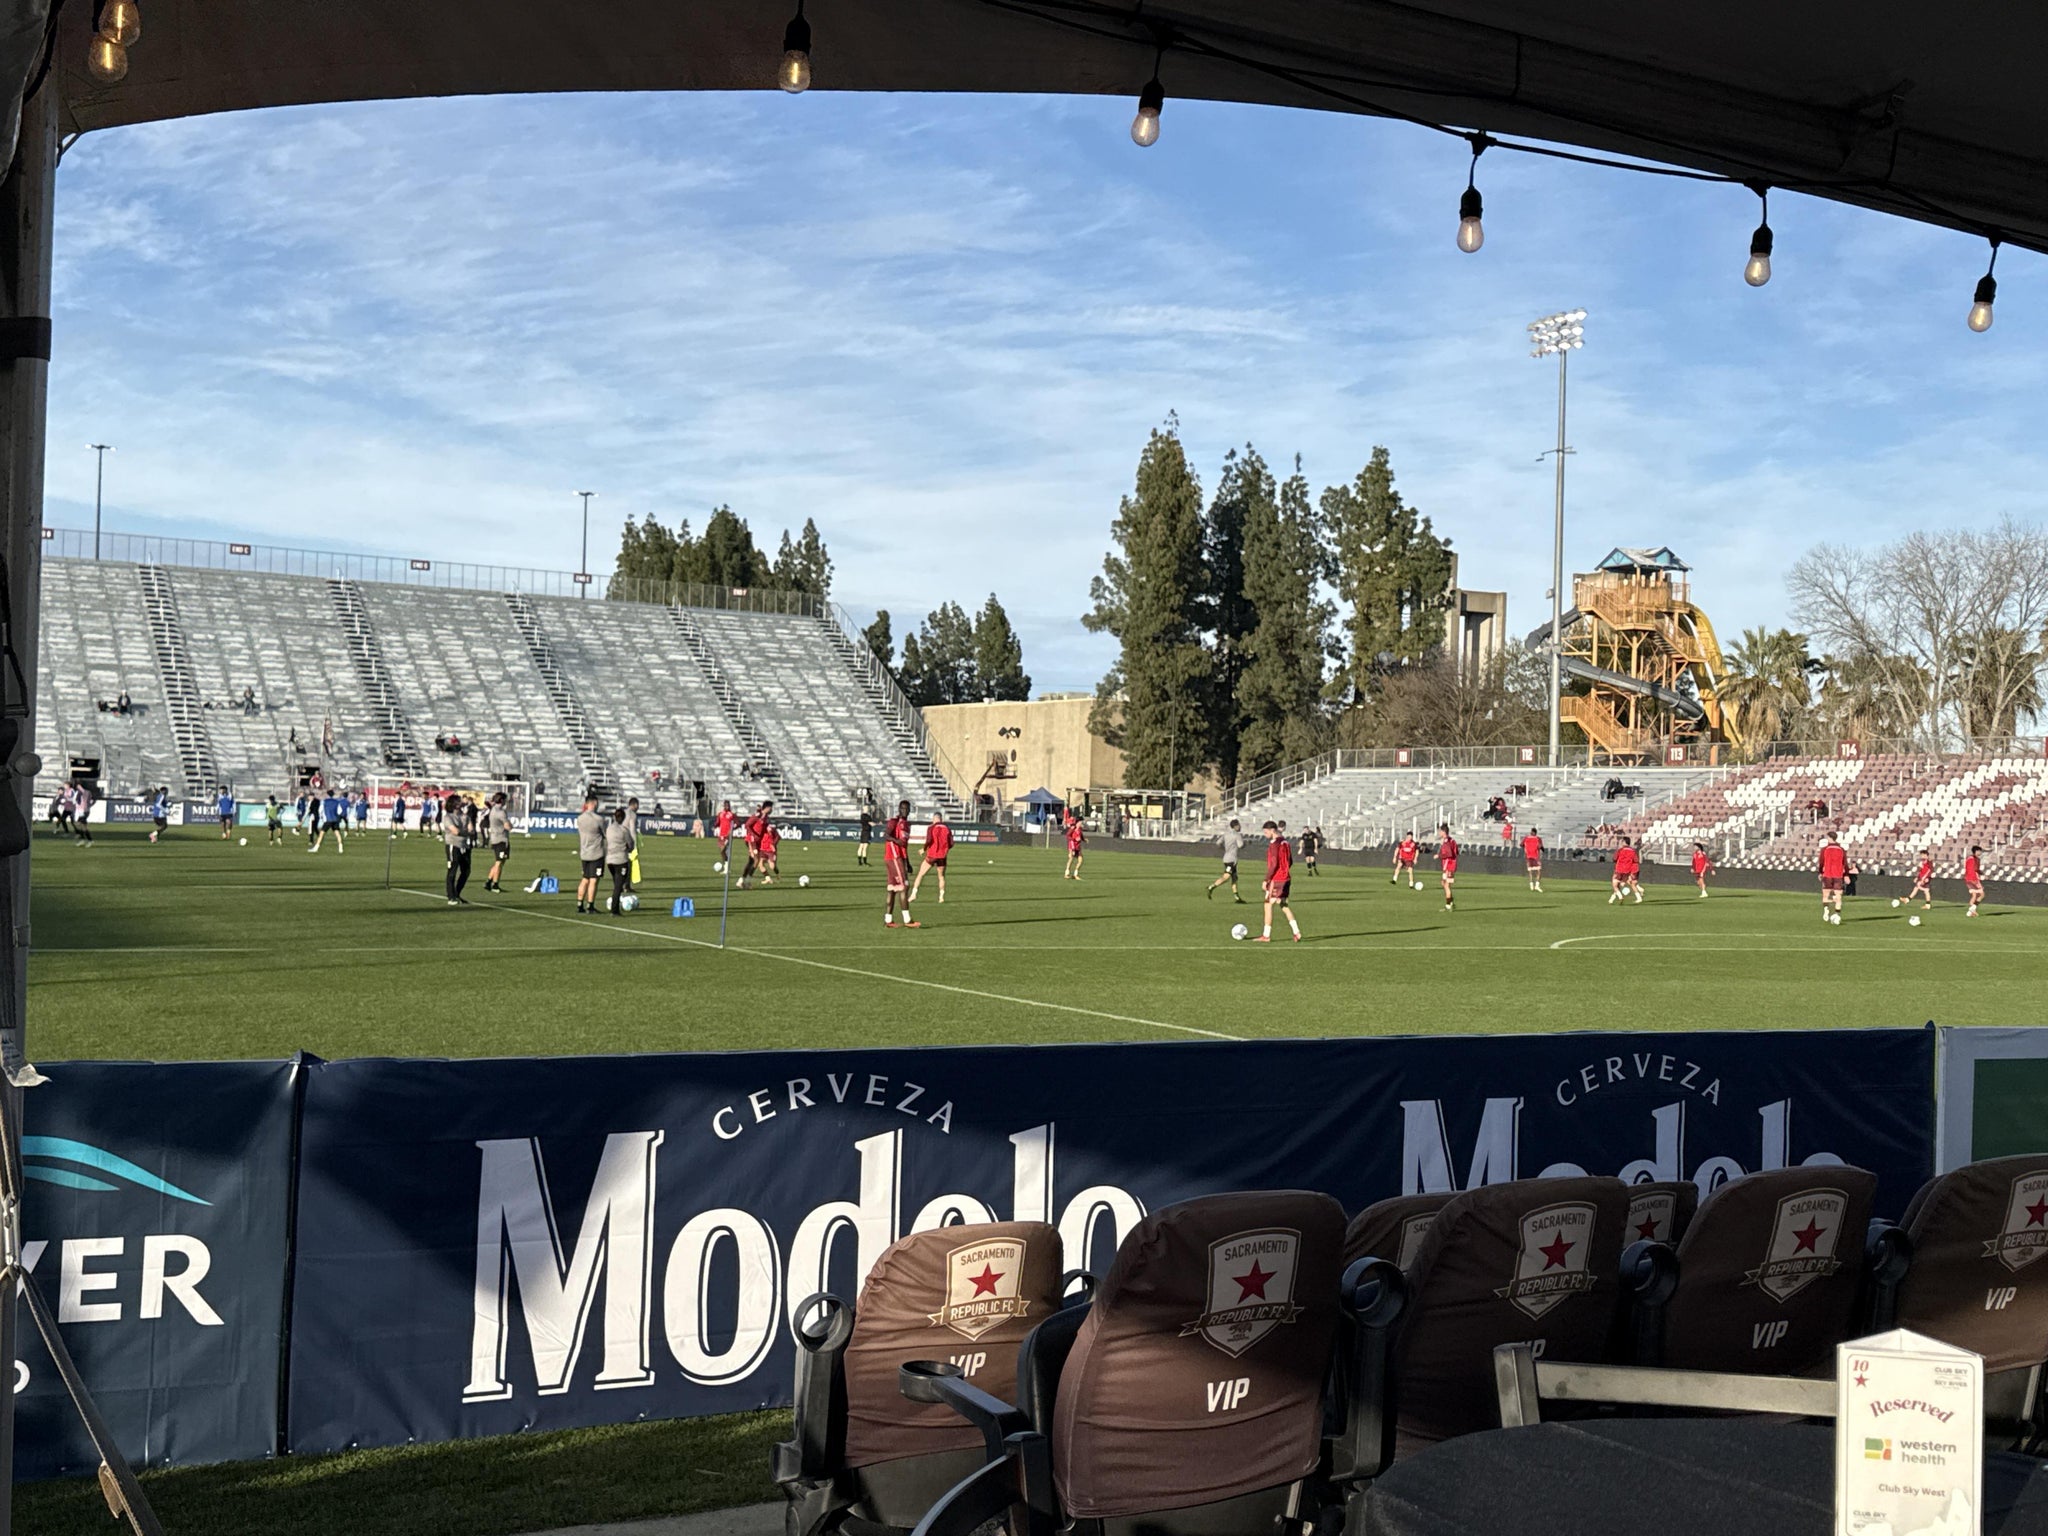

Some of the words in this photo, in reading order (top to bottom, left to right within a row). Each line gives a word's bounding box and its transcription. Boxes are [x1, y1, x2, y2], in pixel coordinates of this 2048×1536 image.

[1521, 748, 1533, 761] 112
[1670, 747, 1684, 761] 113
[1841, 743, 1857, 757] 114
[1557, 1052, 1722, 1106] CERVEZA
[712, 1072, 954, 1140] CERVEZA
[1789, 1199, 1840, 1216] SACRAMENTO
[1531, 1212, 1586, 1233] SACRAMENTO
[961, 1247, 1015, 1266] SACRAMENTO
[1224, 1240, 1288, 1262] SACRAMENTO
[1767, 1259, 1817, 1277] REPUBLIC
[1517, 1275, 1569, 1297] REPUBLIC
[1570, 1273, 1584, 1289] FC
[1984, 1286, 2018, 1311] VIP
[950, 1303, 1000, 1321] REPUBLIC
[1002, 1299, 1015, 1313] FC
[1208, 1307, 1269, 1327] REPUBLIC
[1270, 1305, 1286, 1319] FC
[1752, 1320, 1789, 1349] VIP
[1853, 1359, 1869, 1372] 10
[1206, 1377, 1250, 1413] VIP
[1870, 1398, 1955, 1424] Reserved
[1900, 1439, 1957, 1453] western
[1902, 1452, 1946, 1466] health
[1879, 1483, 1901, 1494] Club
[1903, 1485, 1920, 1497] Sky
[1921, 1486, 1946, 1498] West
